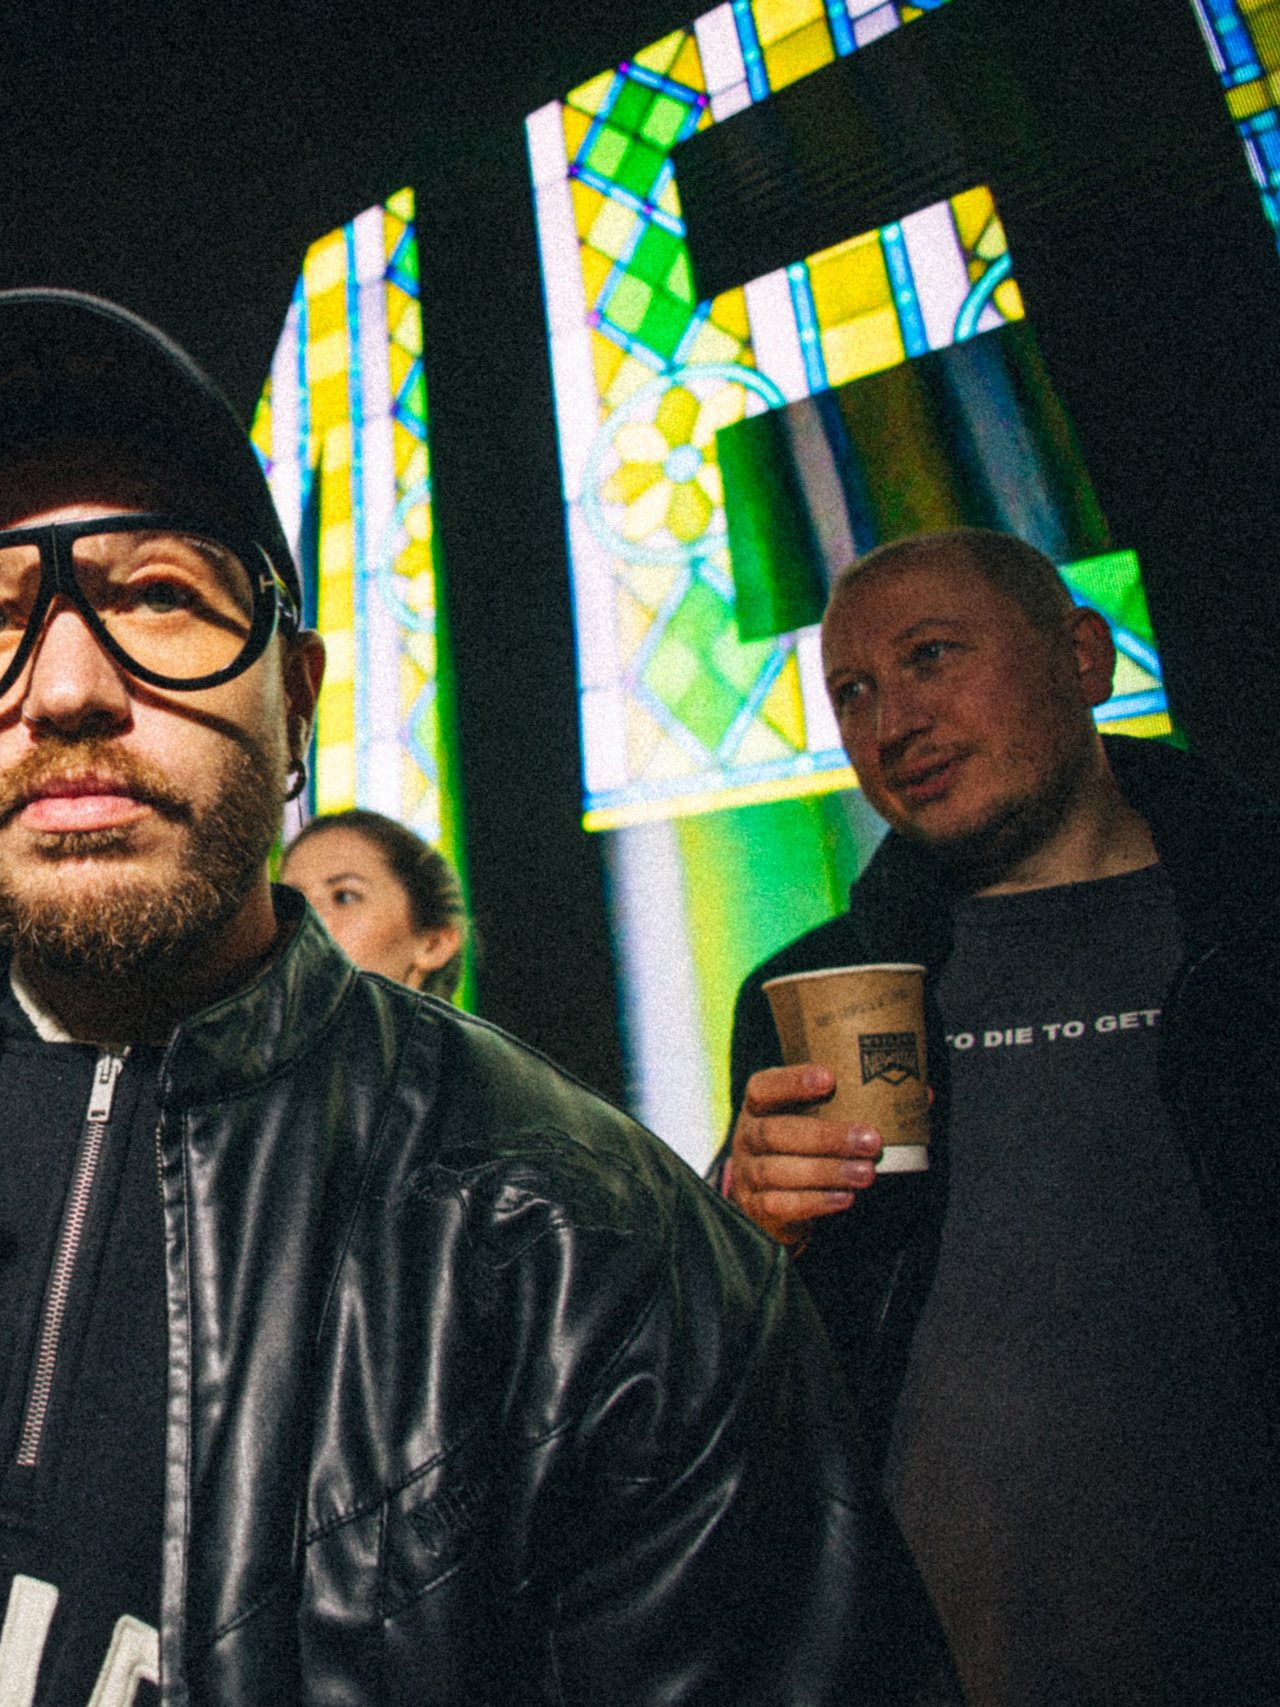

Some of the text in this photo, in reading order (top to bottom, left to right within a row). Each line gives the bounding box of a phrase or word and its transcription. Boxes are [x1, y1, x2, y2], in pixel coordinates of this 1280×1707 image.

[983, 1027, 1033, 1048] DIE
[1041, 1021, 1085, 1041] TO
[1094, 1009, 1162, 1033] GET
